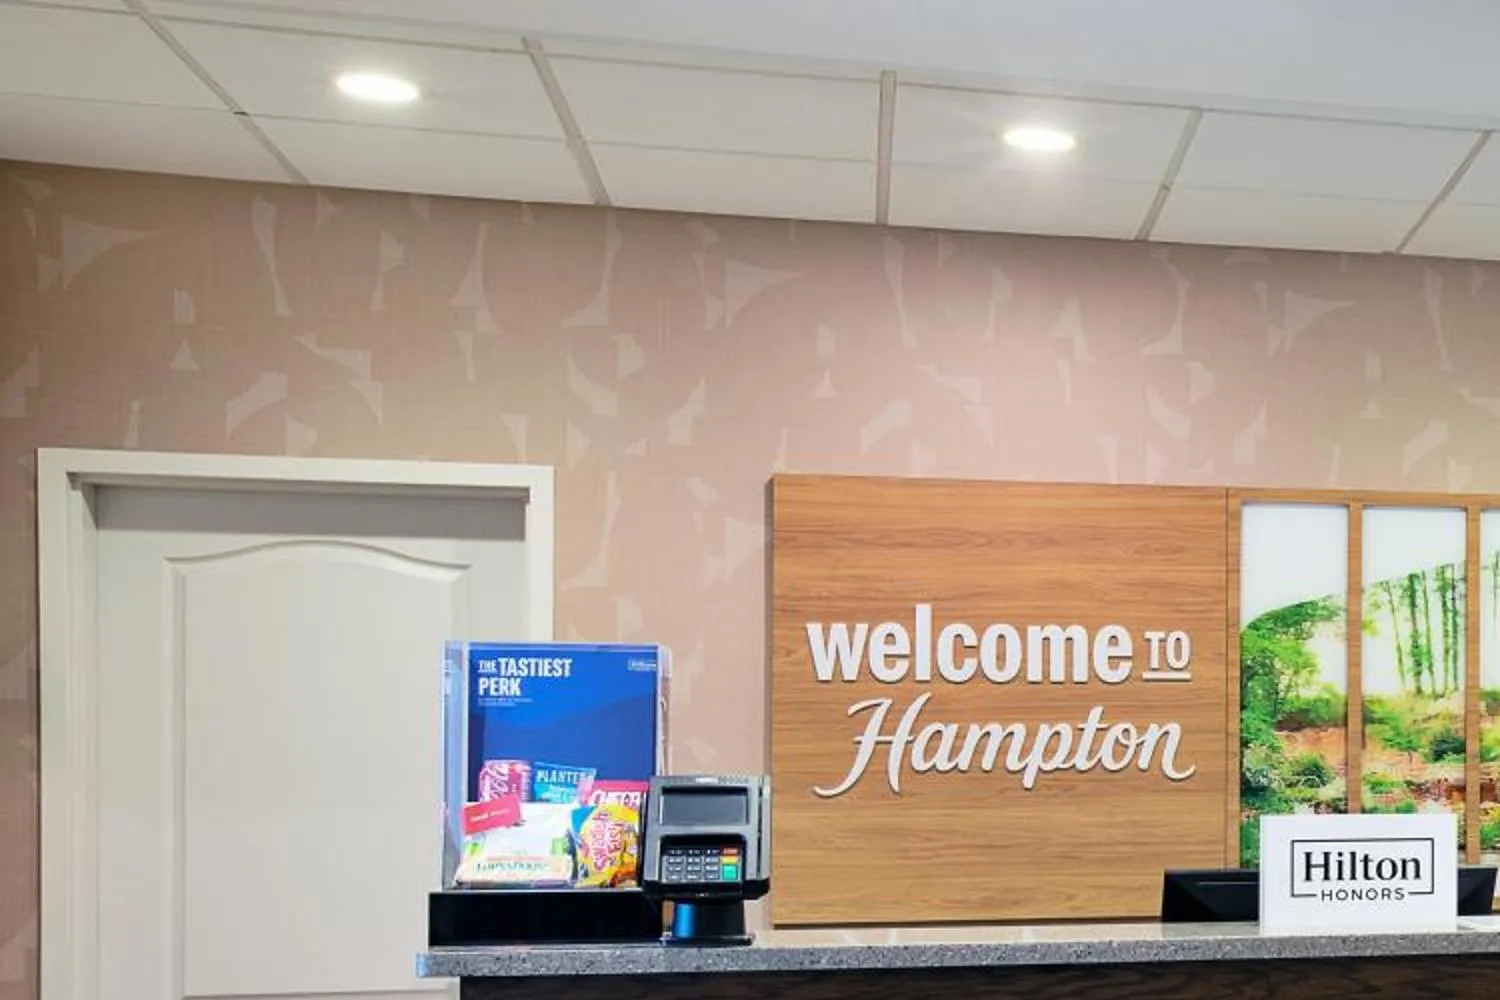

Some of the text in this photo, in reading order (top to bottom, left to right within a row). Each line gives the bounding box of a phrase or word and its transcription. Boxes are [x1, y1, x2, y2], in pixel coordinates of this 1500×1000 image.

[806, 603, 1192, 683] welcome TO
[498, 657, 573, 678] TASTIEST
[478, 677, 522, 697] PERK
[813, 692, 1196, 797] Hampton
[1303, 851, 1422, 882] Hilton
[1321, 887, 1406, 901] HONORS
